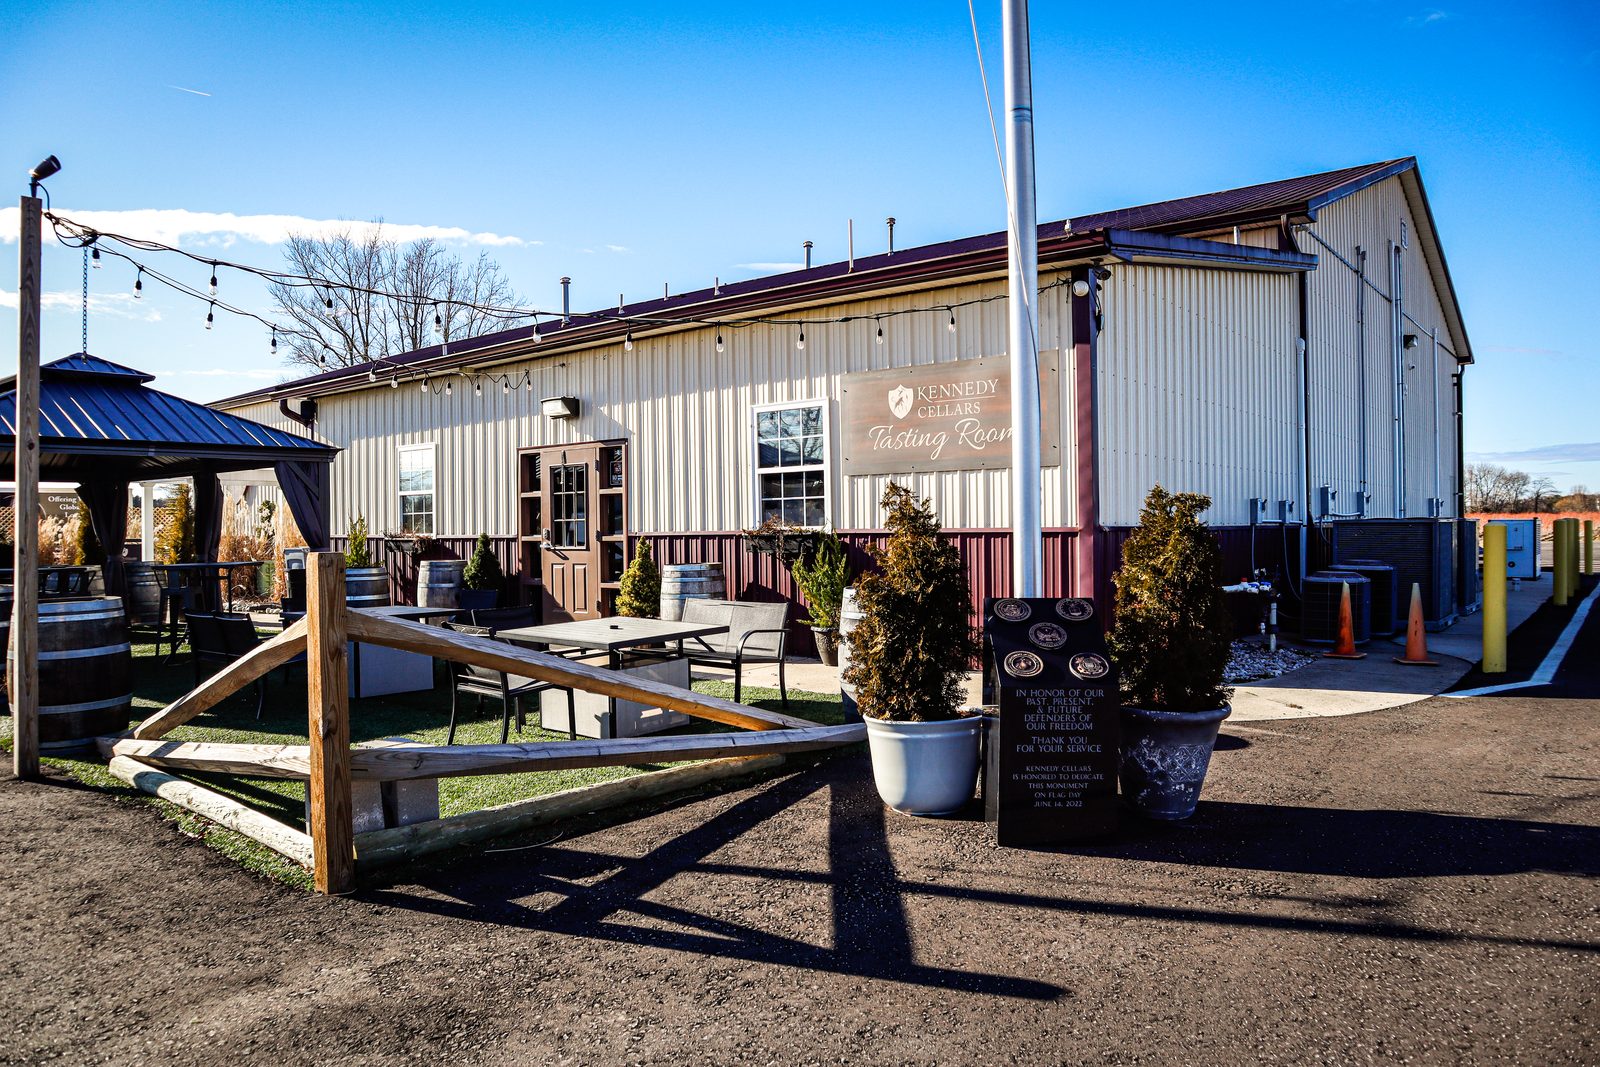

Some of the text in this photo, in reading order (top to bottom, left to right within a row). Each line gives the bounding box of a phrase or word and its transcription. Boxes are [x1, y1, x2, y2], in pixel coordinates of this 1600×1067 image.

[917, 379, 999, 403] KENNEDY
[918, 402, 981, 418] CELLARS
[869, 425, 950, 460] Tasting
[1024, 714, 1092, 722] DEFENDERS OF
[1026, 722, 1093, 730] OUR FREEDOM
[1032, 736, 1088, 744] THANK YOU
[1016, 744, 1102, 753] FOR YOUR SERVICE
